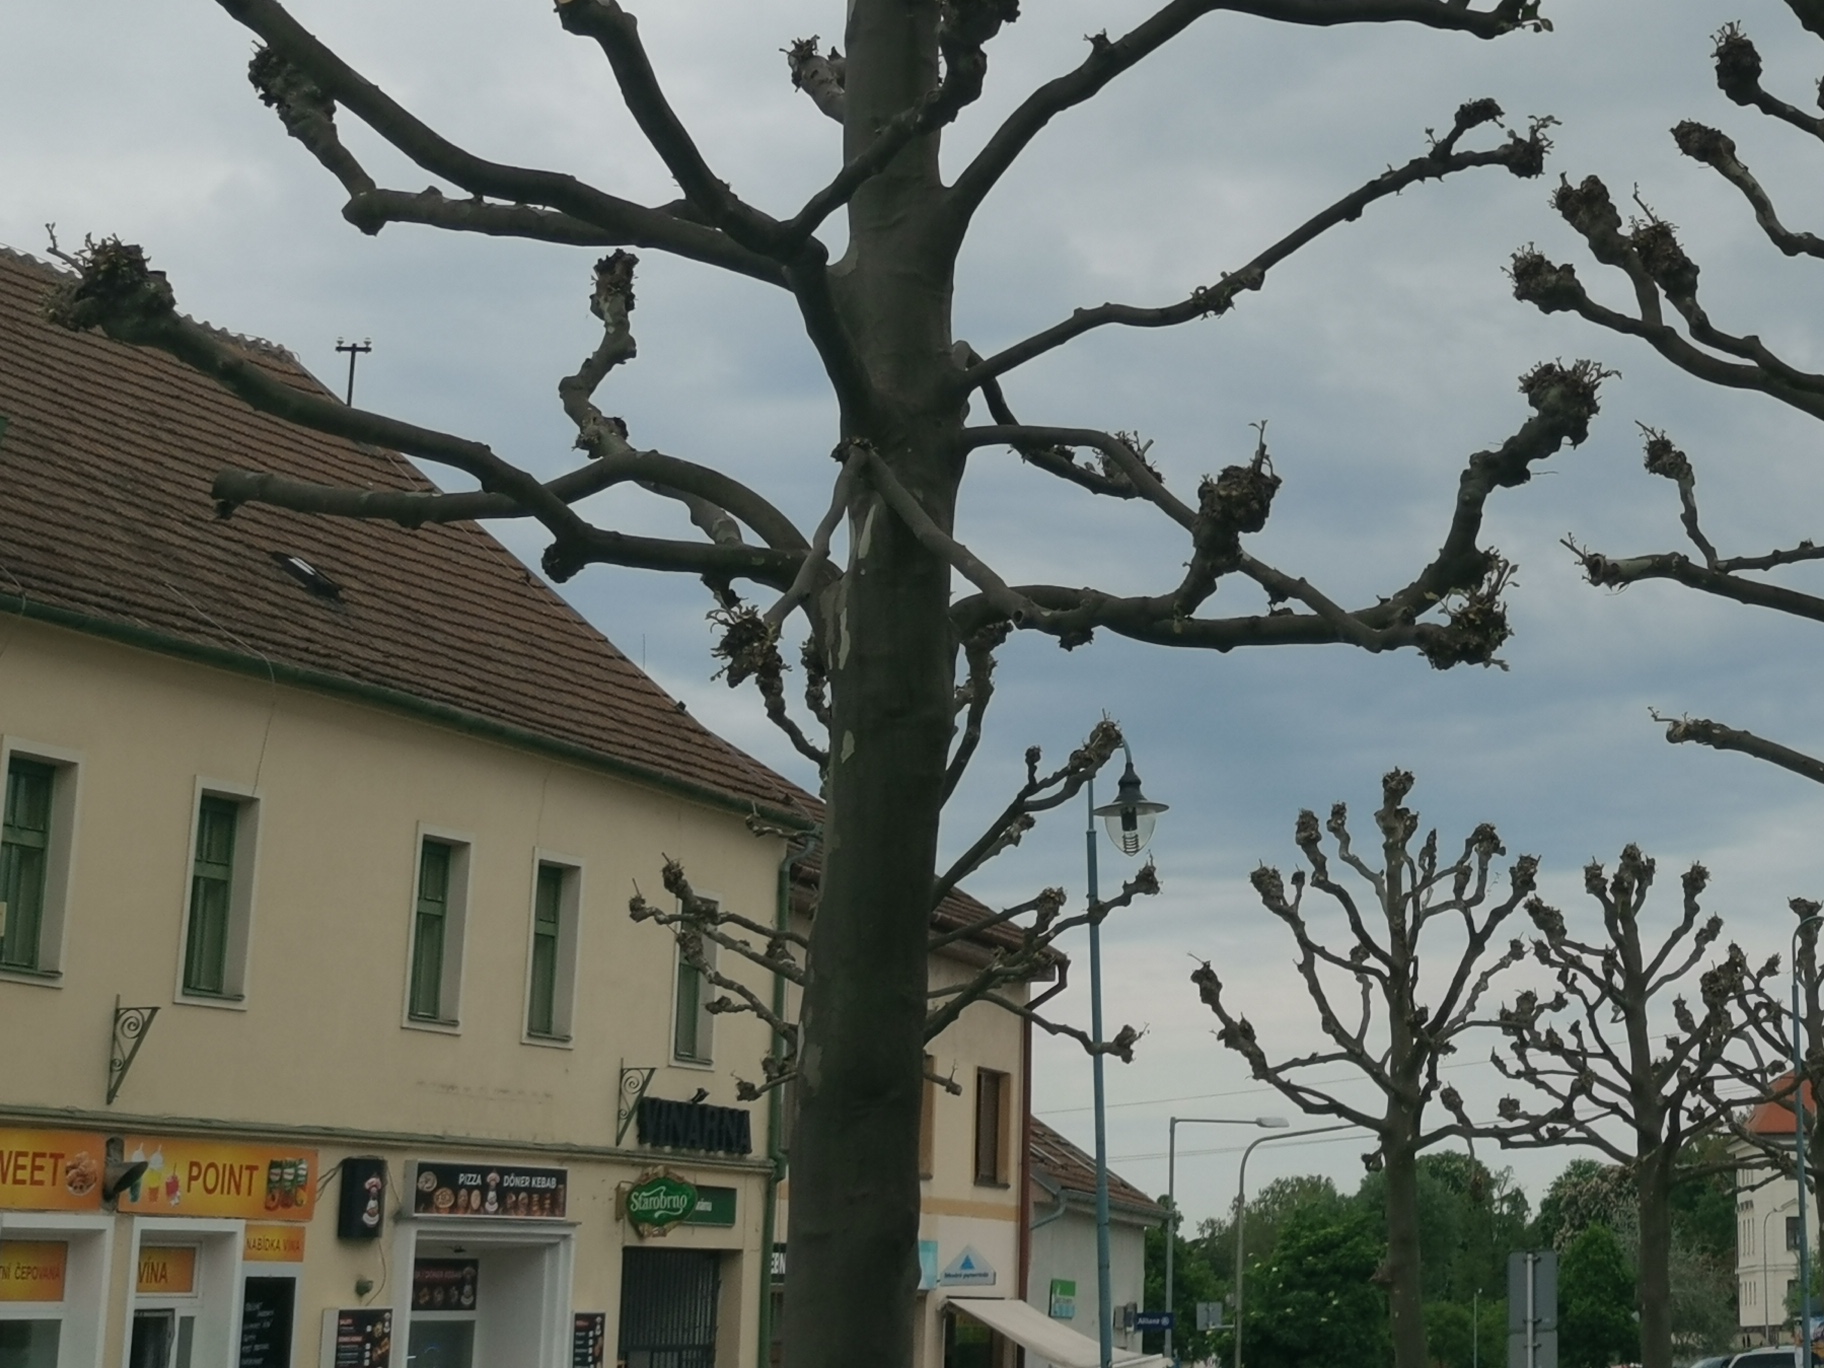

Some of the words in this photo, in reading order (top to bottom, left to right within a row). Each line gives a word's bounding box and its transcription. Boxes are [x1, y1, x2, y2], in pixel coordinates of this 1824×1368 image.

[187, 1161, 259, 1196] POINT
[458, 1173, 482, 1185] PIZZA
[531, 1176, 557, 1189] KEBAB
[630, 1186, 688, 1219] Starobrno
[246, 1235, 281, 1251] NABÍDKA
[138, 1257, 168, 1283] VÍNA
